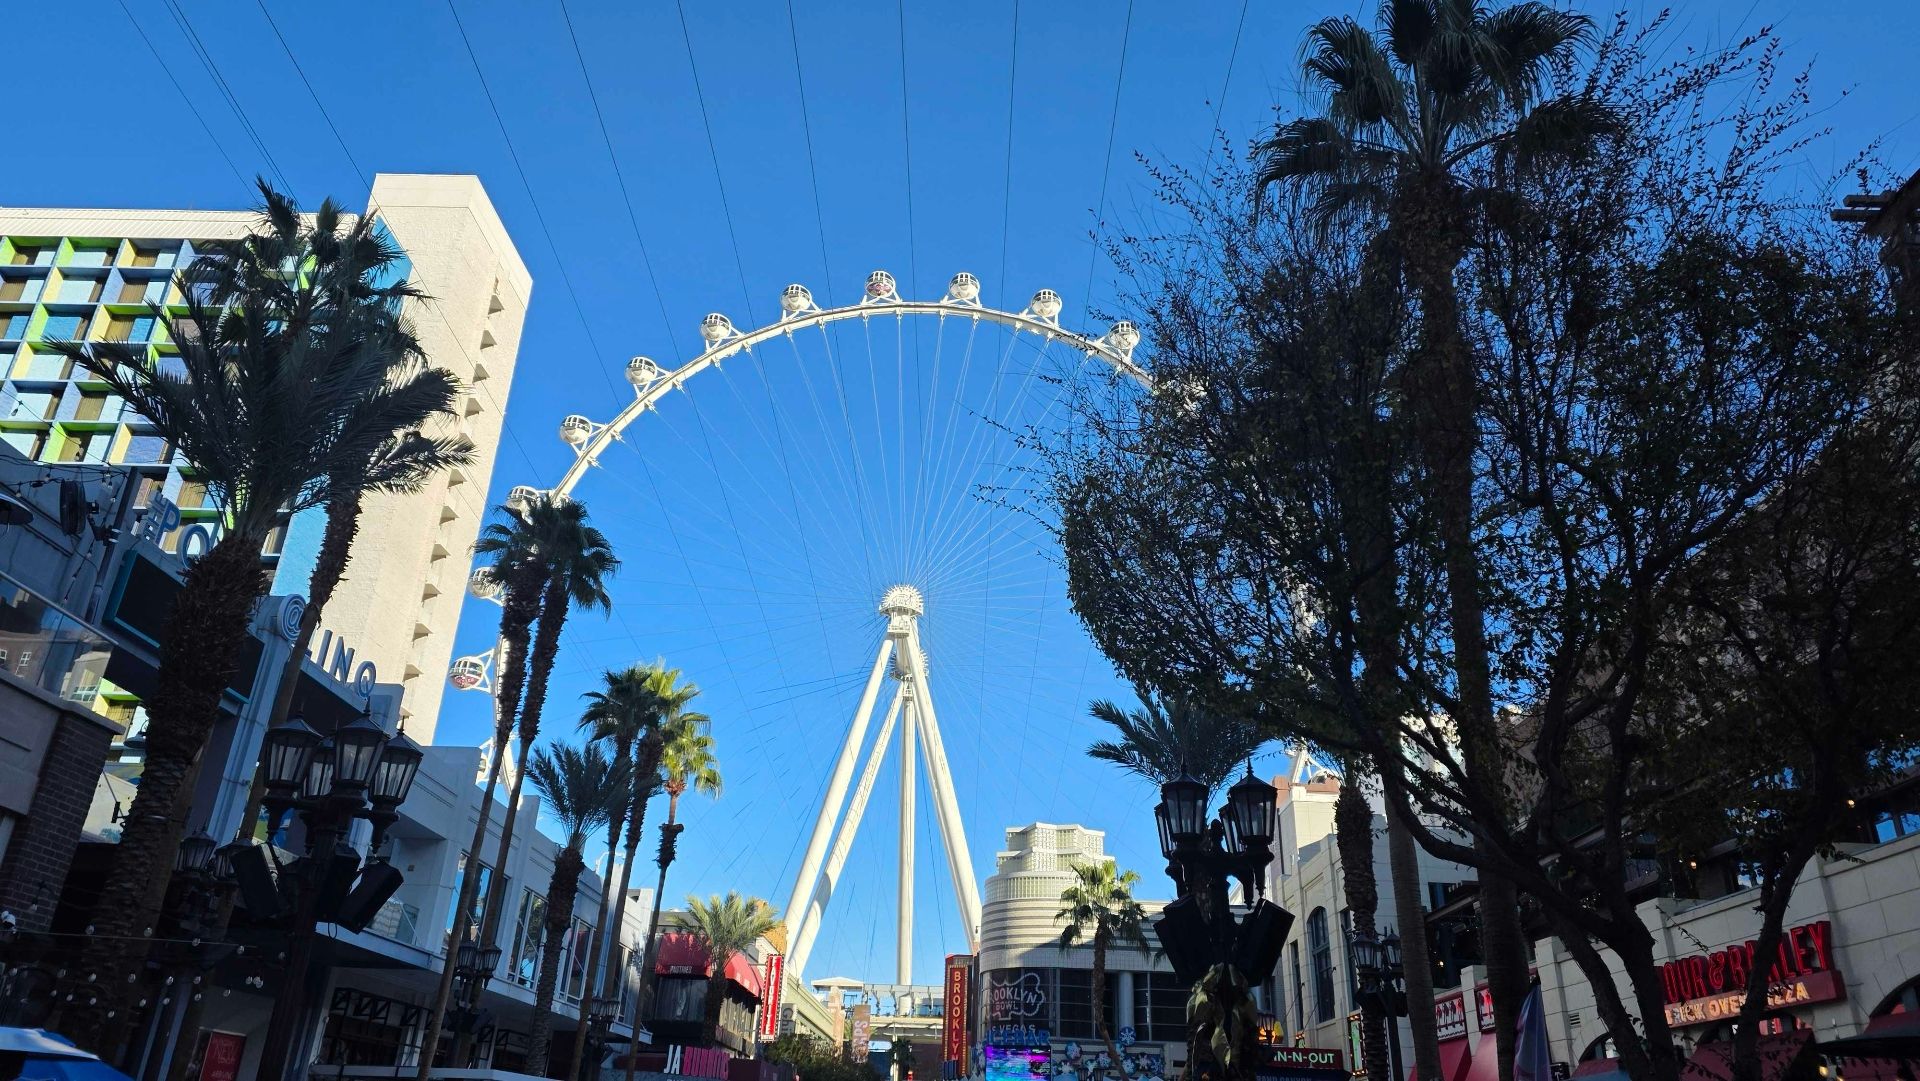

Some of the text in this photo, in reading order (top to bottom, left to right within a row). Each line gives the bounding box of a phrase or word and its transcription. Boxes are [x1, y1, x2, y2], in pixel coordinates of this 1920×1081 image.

[306, 629, 376, 698] INQ
[1662, 954, 1709, 1003] OUR
[1726, 920, 1831, 989] BLEY
[991, 987, 1037, 1006] OOKLYN
[996, 1000, 1019, 1011] BOWL
[1767, 981, 1810, 1006] IZZA
